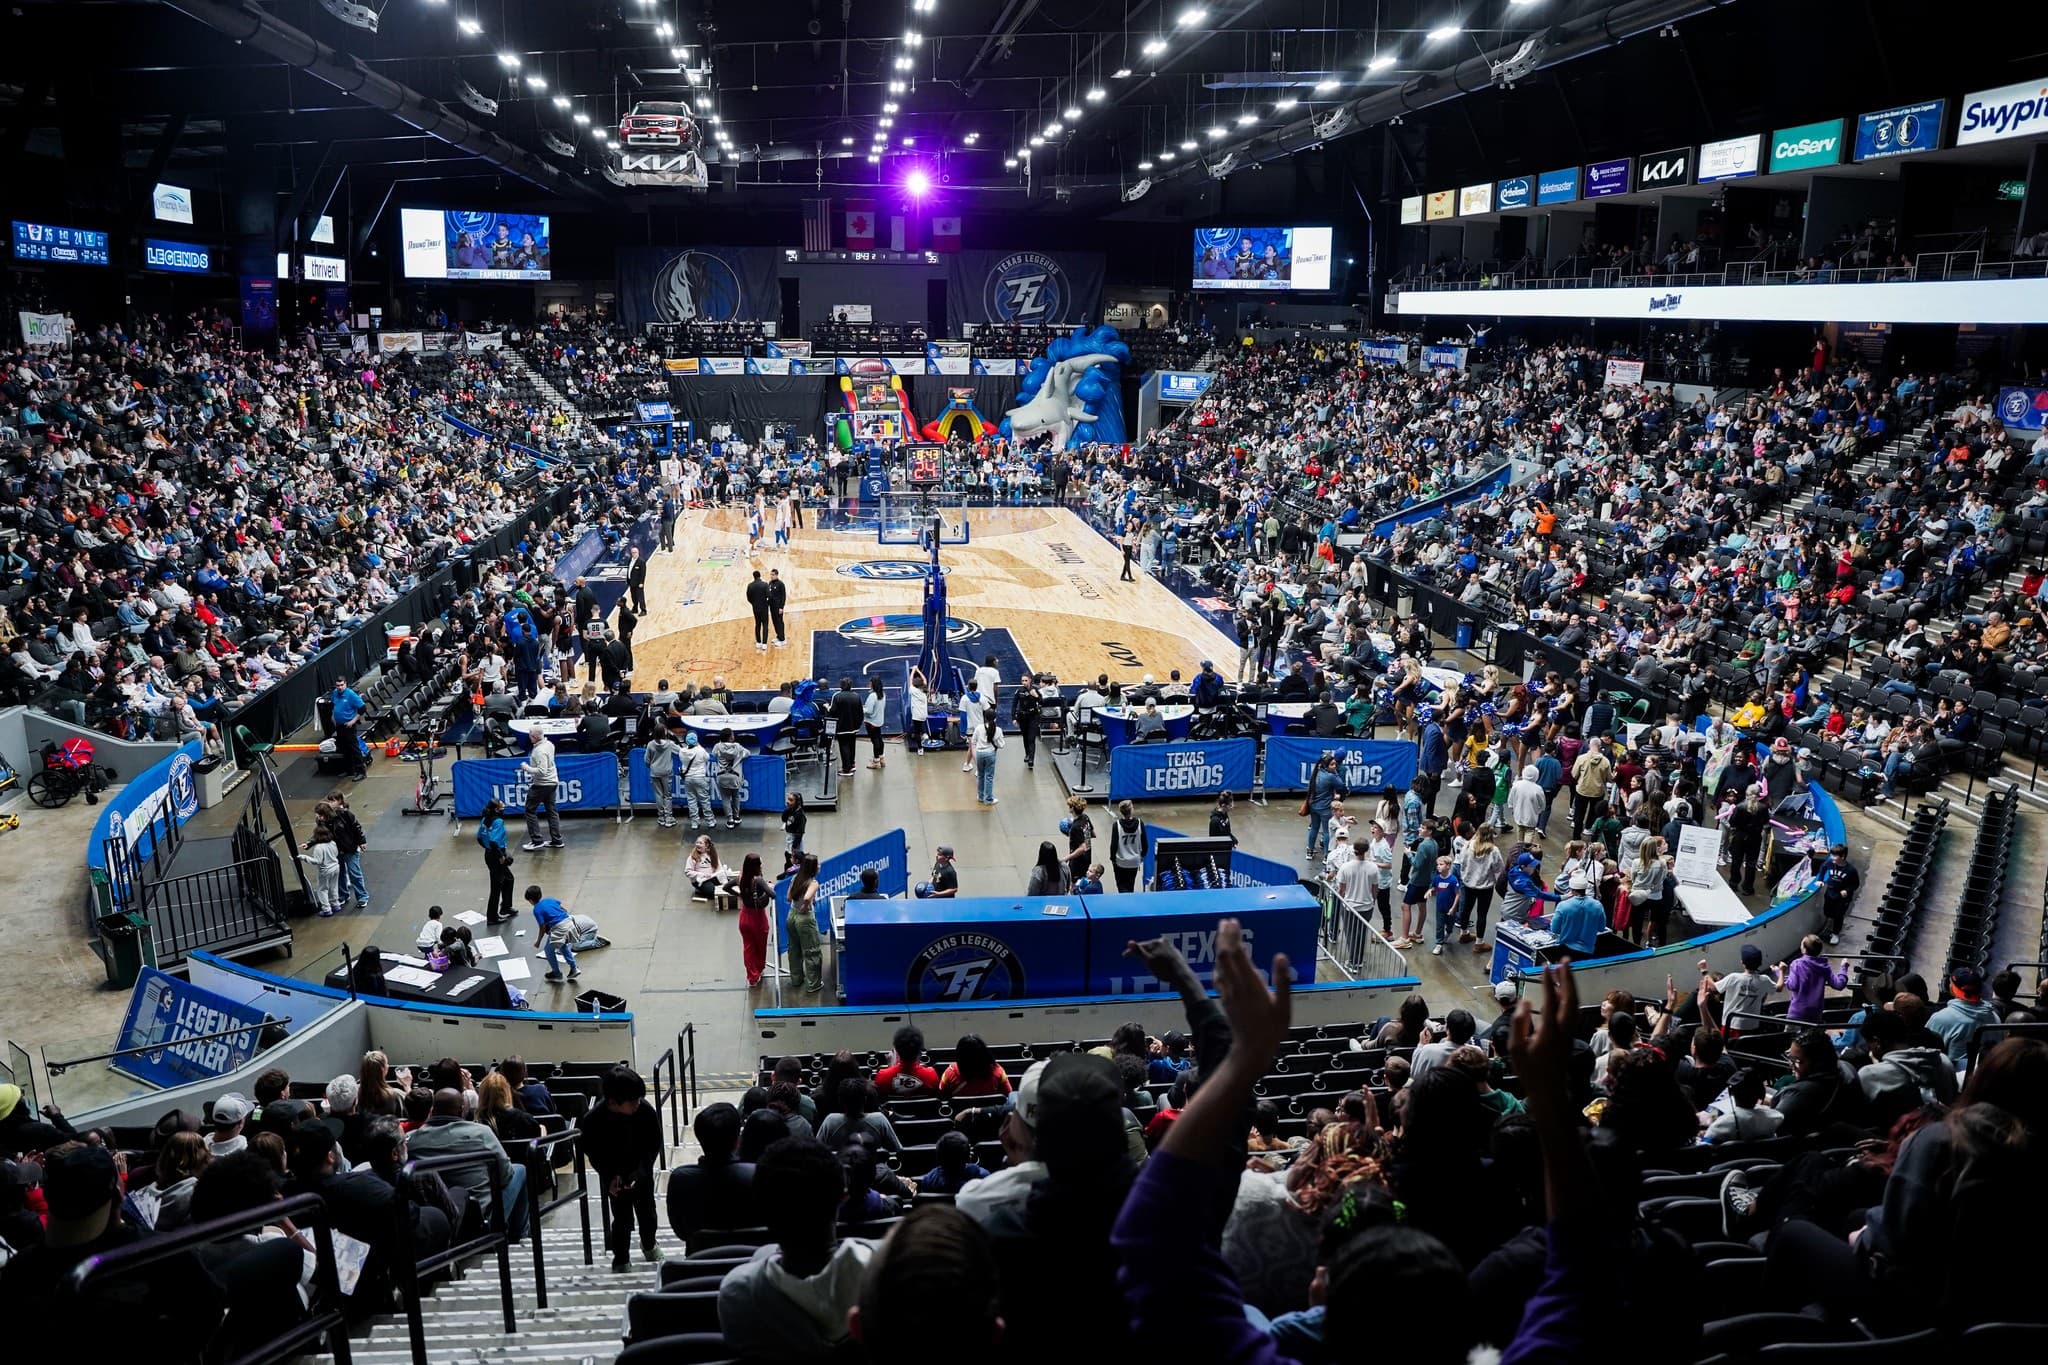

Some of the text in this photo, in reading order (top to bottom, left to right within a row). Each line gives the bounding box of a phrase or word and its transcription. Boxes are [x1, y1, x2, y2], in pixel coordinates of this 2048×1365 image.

[1775, 137, 1837, 159] CoServ
[1643, 158, 1685, 182] KIA
[147, 247, 209, 269] LEGENDS
[997, 254, 1060, 275] TEXAS LEGENDS
[311, 260, 339, 279] thrivent
[914, 461, 937, 480] 24
[1166, 751, 1205, 767] TEXAS
[1145, 764, 1224, 791] LEGENDS
[1121, 833, 1137, 845] 77
[922, 934, 1009, 961] TEXAS LEGENDS
[176, 997, 253, 1050] LEGENDS
[167, 1024, 229, 1073] LOCKER
